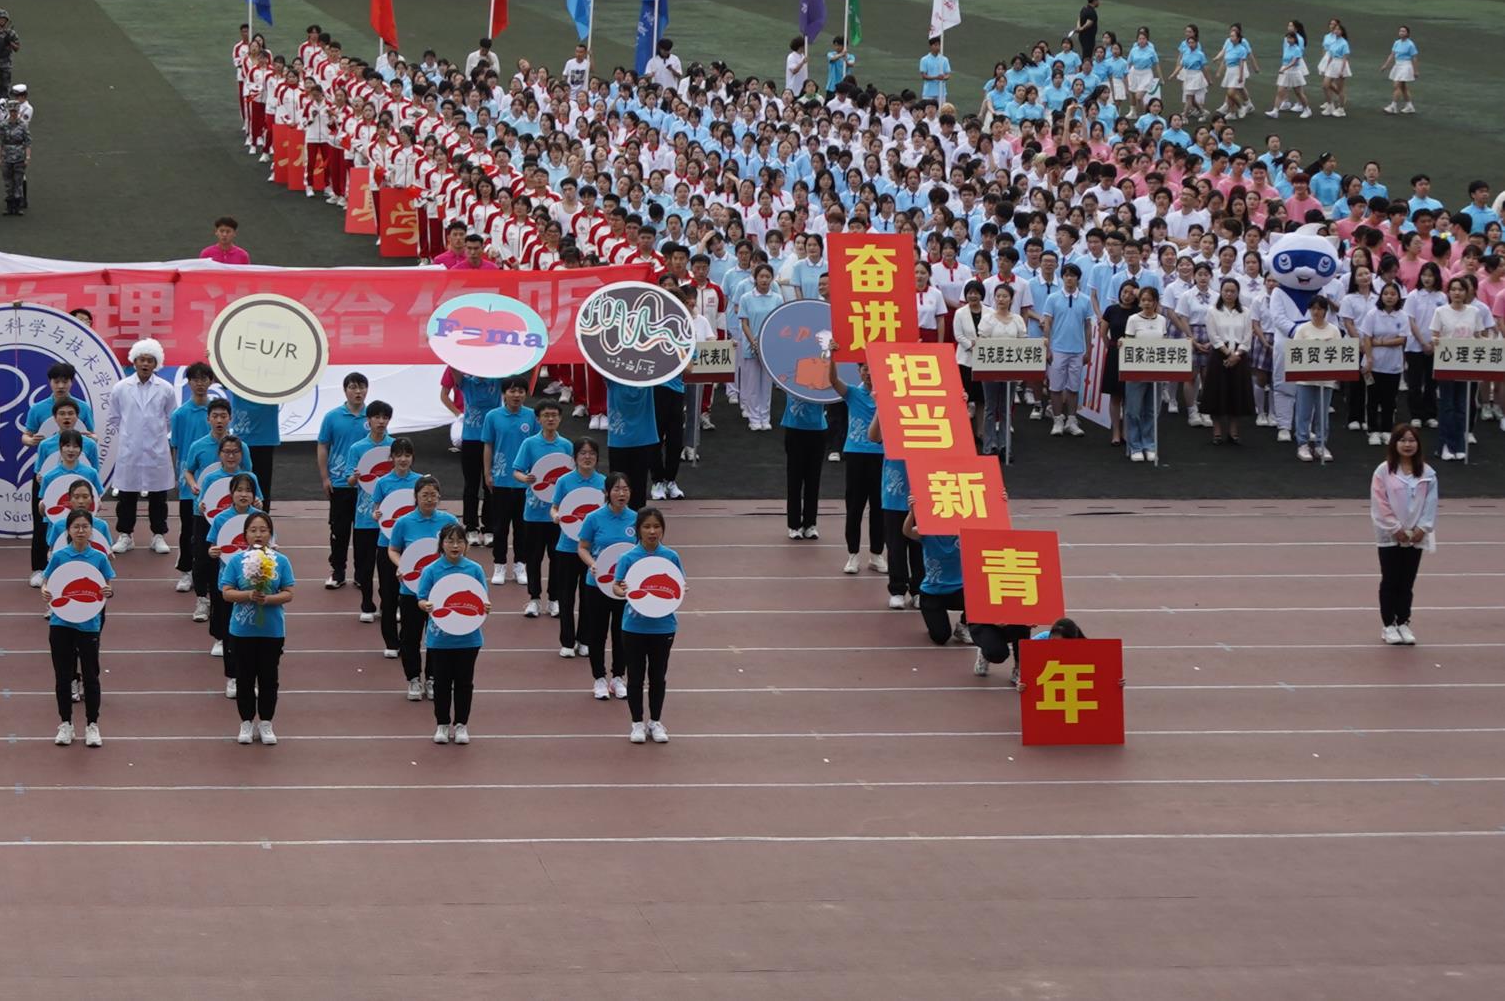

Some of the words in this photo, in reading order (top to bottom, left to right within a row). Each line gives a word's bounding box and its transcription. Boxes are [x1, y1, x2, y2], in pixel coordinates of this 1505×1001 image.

[237, 334, 298, 360] I=U/R
[433, 317, 545, 349] F=ma
[977, 346, 1043, 364] 马克思主义学院
[1123, 346, 1188, 364] 国家治理学院
[1290, 345, 1355, 364] 商贸学院
[1439, 345, 1503, 364] 心理学部
[886, 353, 954, 449] 担当
[927, 471, 986, 519] 新
[981, 548, 1043, 607] 青
[1035, 660, 1099, 724] 年
